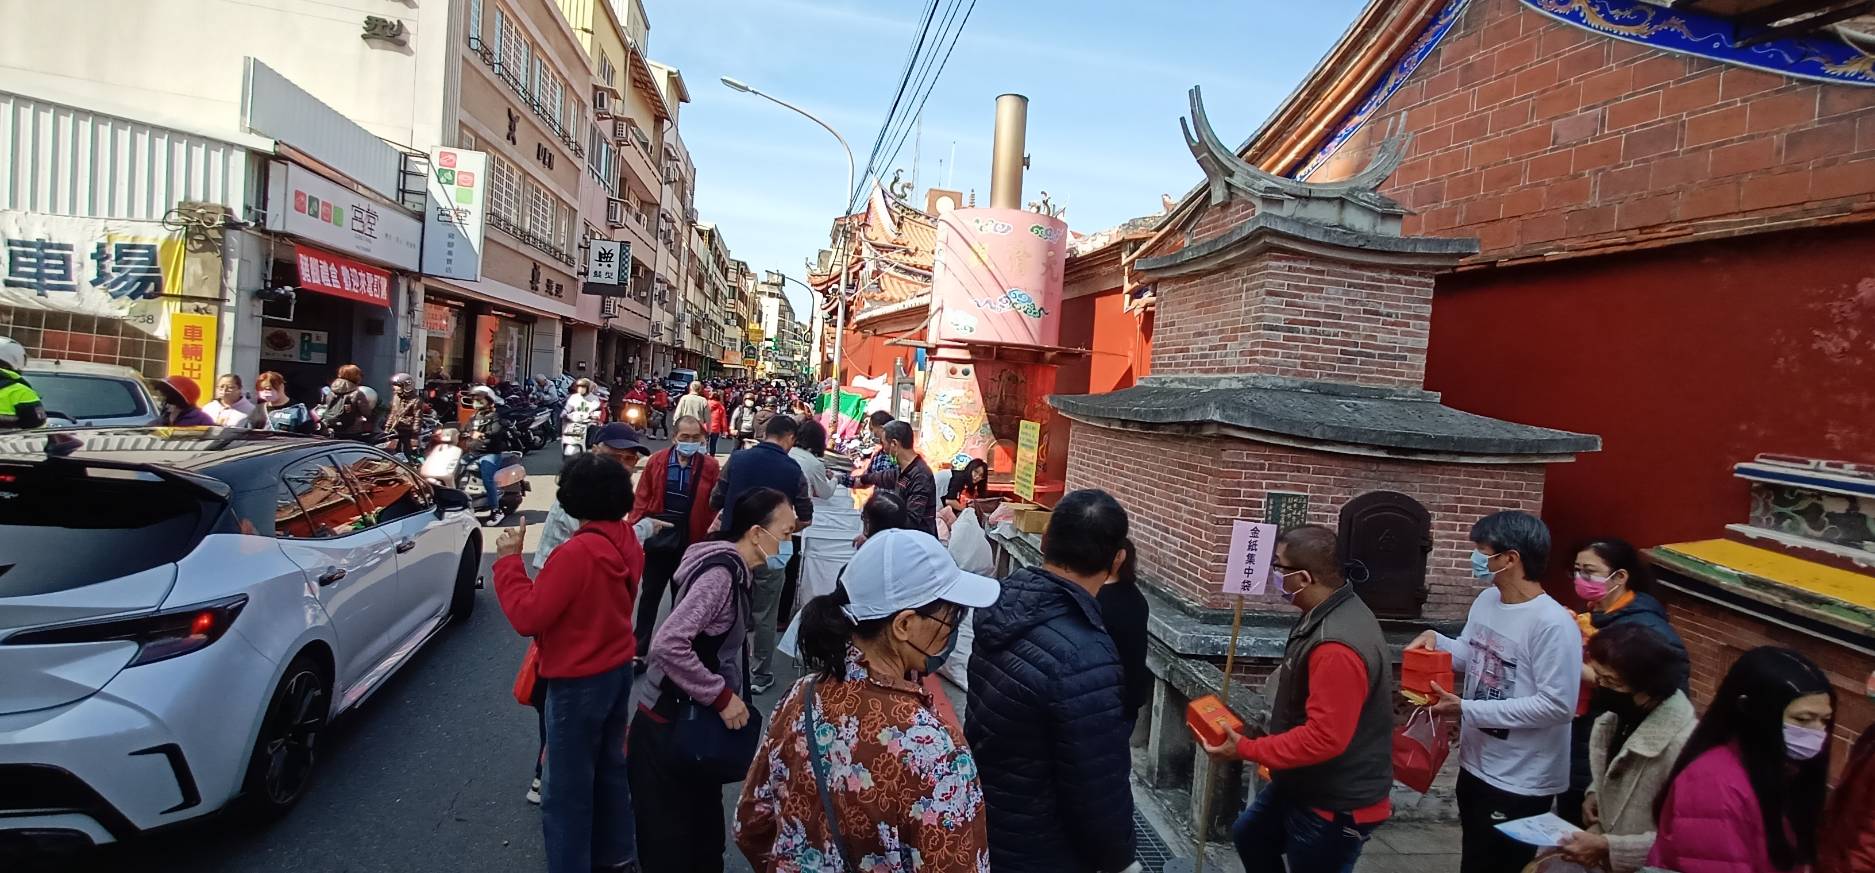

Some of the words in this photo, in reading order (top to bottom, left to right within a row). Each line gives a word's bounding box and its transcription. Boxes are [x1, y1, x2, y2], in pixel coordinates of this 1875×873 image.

[4, 238, 163, 300] 車場
[1241, 526, 1260, 592] 金紙集中袋
